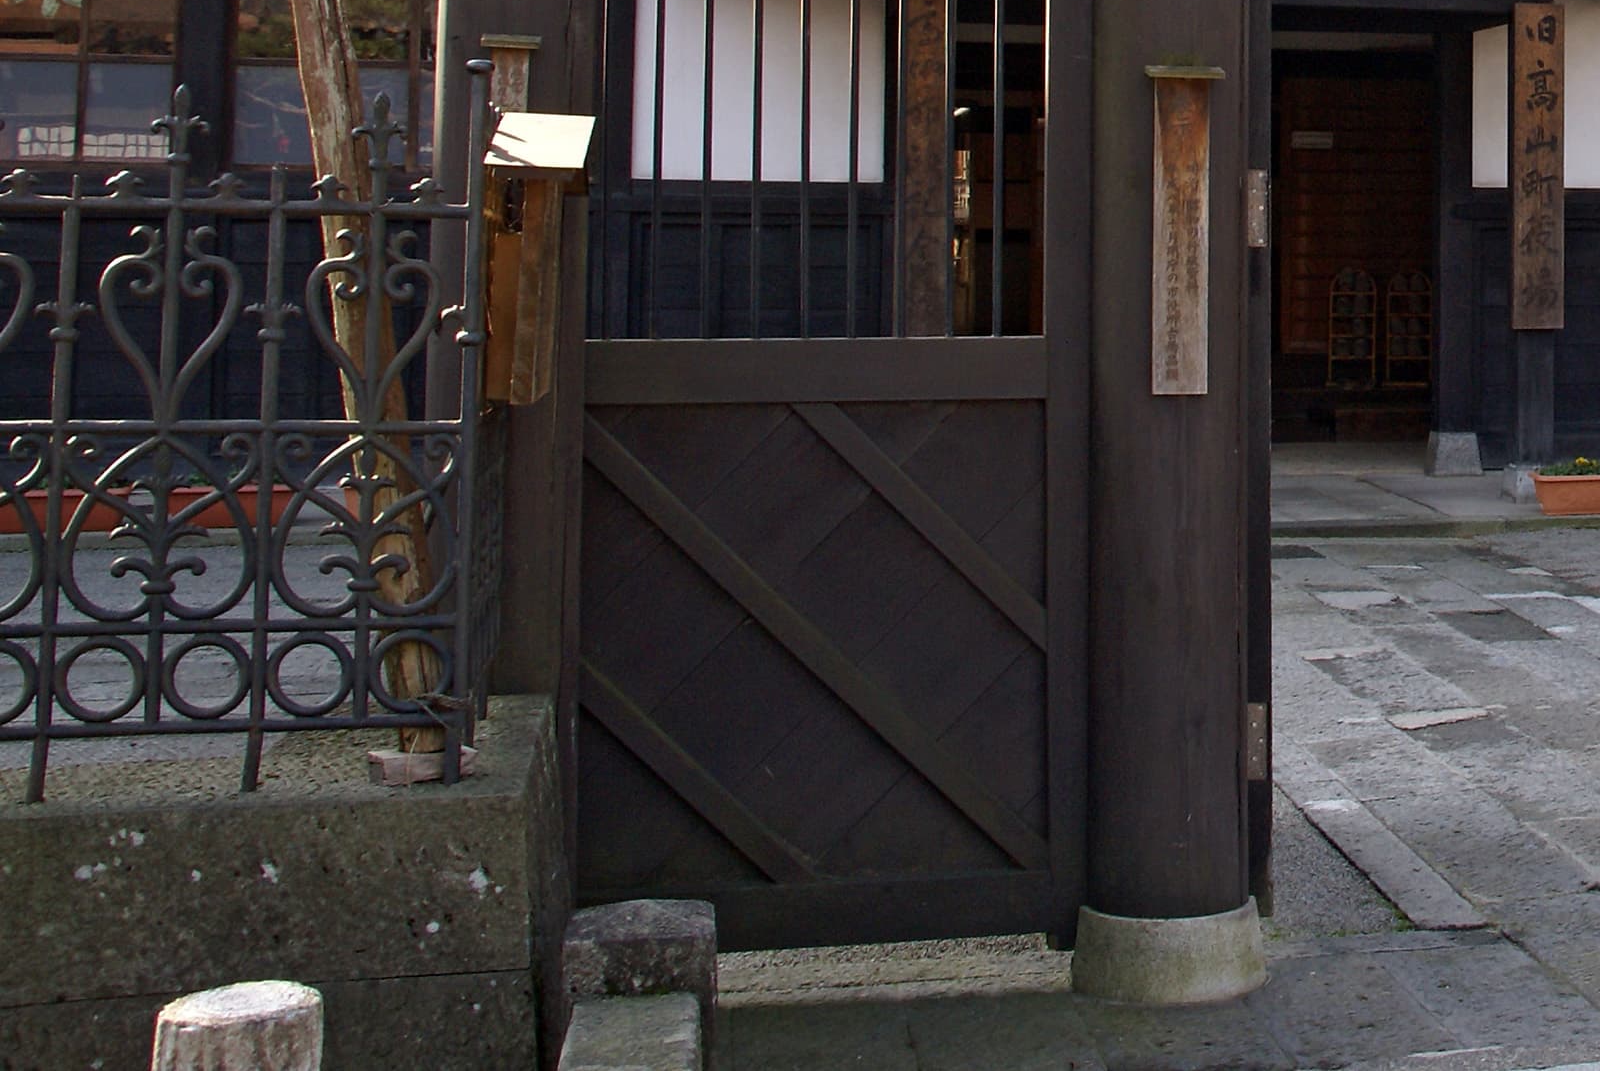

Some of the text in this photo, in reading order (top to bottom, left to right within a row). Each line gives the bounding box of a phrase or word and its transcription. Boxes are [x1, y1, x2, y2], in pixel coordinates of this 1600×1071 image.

[1518, 14, 1560, 309] 旧高山町役場
